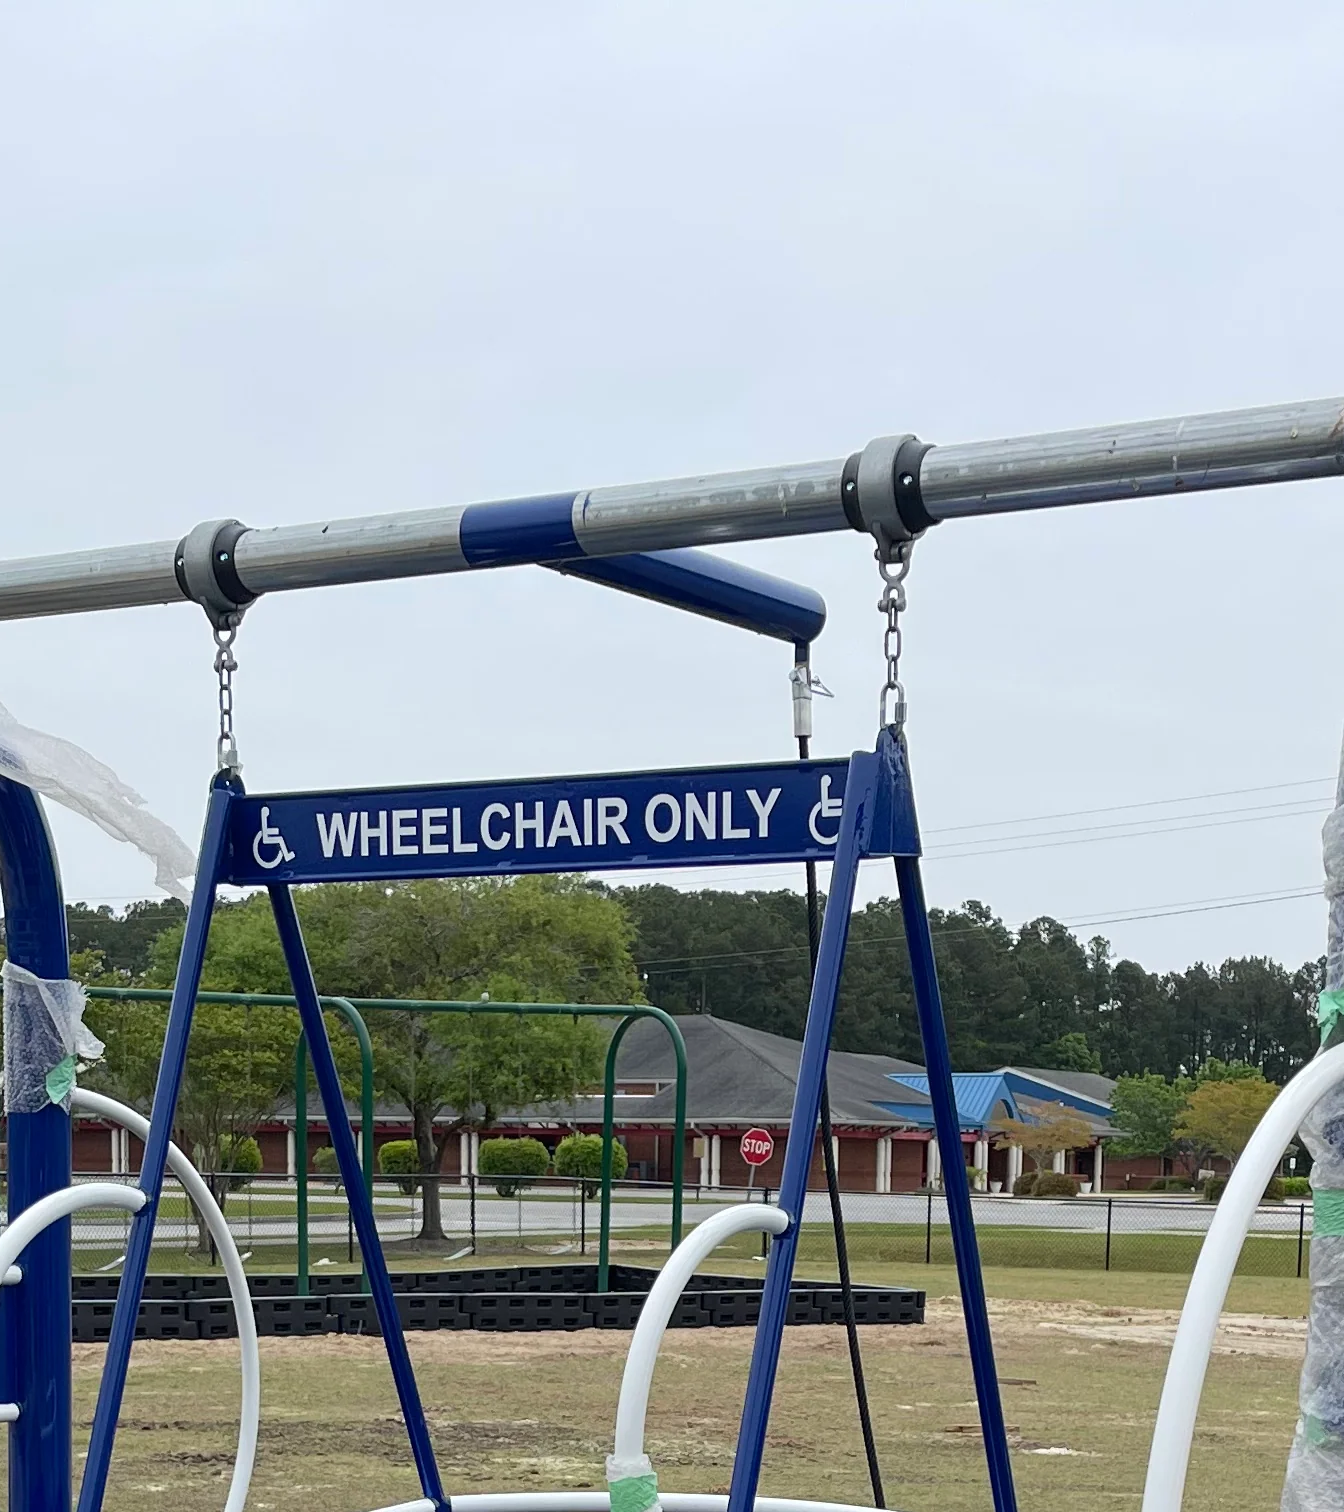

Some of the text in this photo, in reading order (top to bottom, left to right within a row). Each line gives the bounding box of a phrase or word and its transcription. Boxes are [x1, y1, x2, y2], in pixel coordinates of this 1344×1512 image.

[316, 788, 782, 859] WHEELCHAIR ONLY
[743, 1139, 771, 1155] STOP
